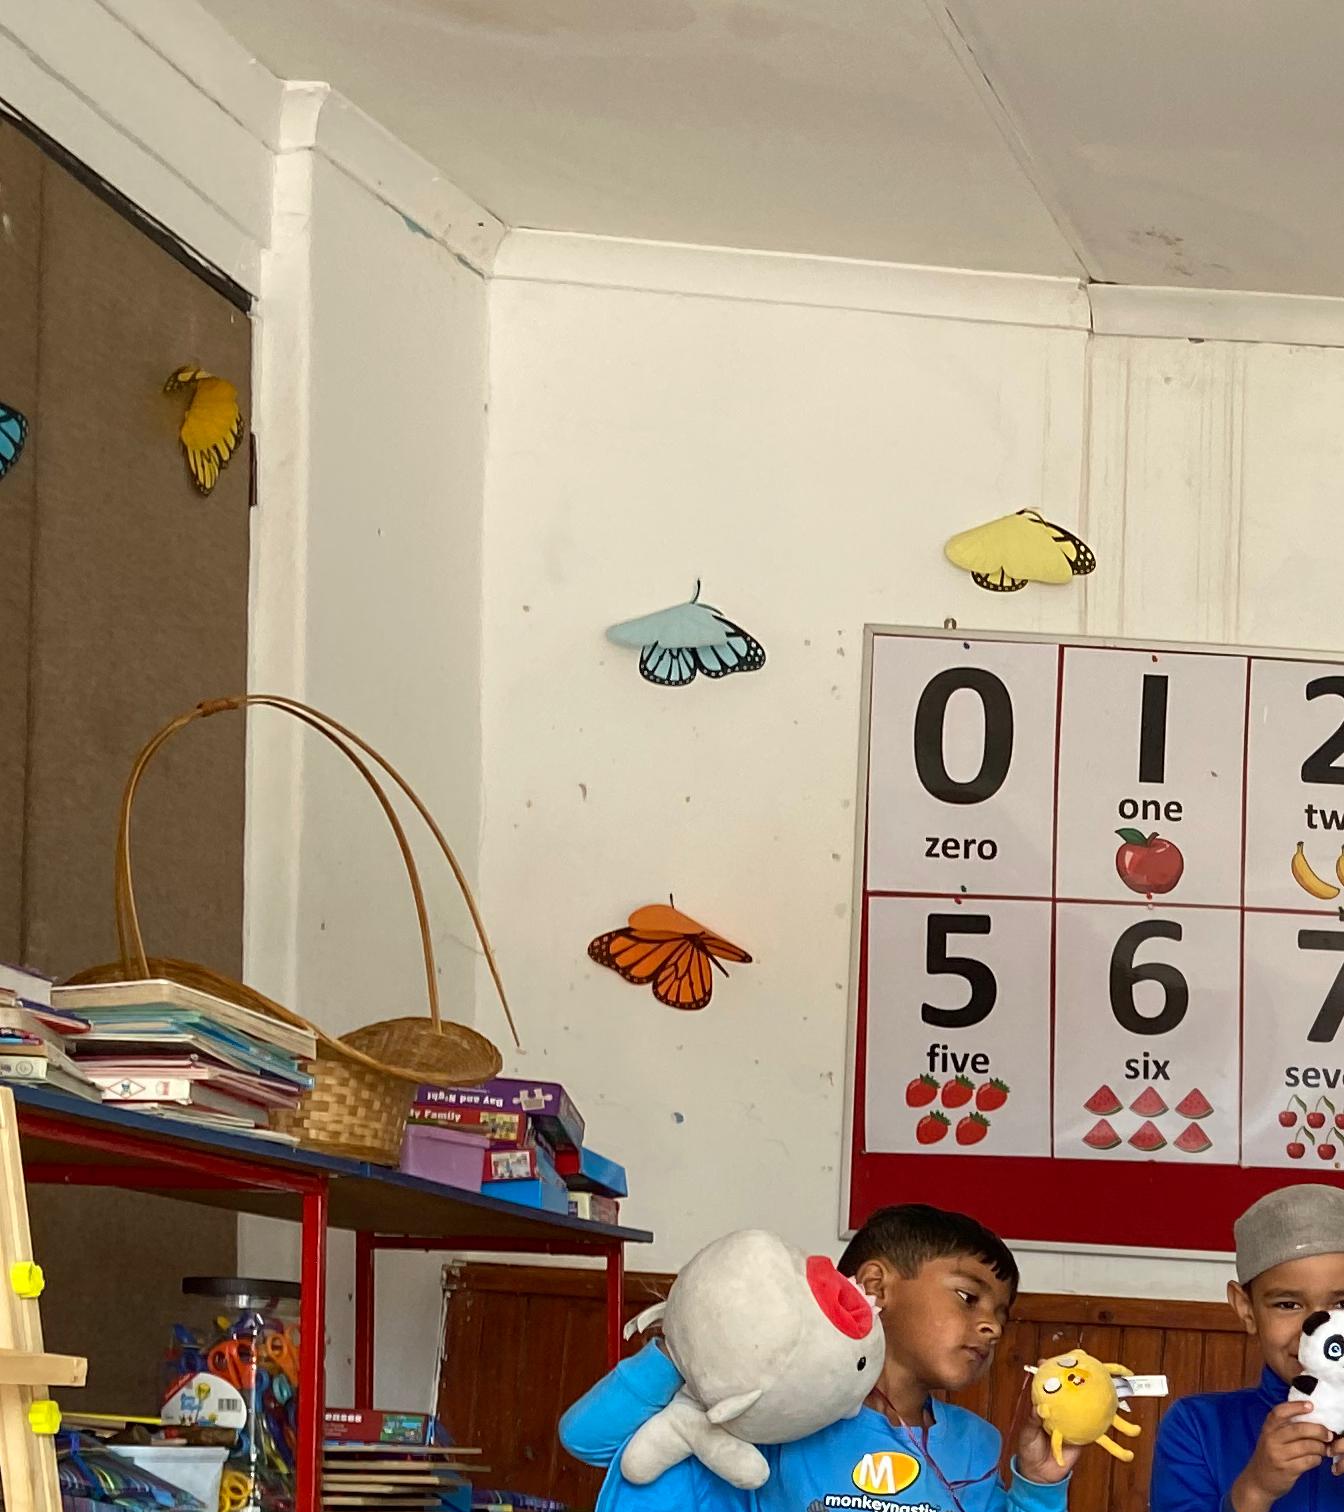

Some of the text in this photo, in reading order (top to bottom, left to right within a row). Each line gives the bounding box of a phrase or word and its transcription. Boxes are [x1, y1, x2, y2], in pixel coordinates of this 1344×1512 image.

[914, 667, 1013, 805] 0
[1139, 674, 1168, 783] 1
[1119, 799, 1182, 821] one
[925, 837, 997, 860] zero
[921, 914, 997, 1028] 5
[1110, 920, 1188, 1035] 6
[927, 1044, 989, 1073] five
[1125, 1052, 1170, 1080] six
[424, 1109, 461, 1122] Family
[859, 1454, 896, 1493] M
